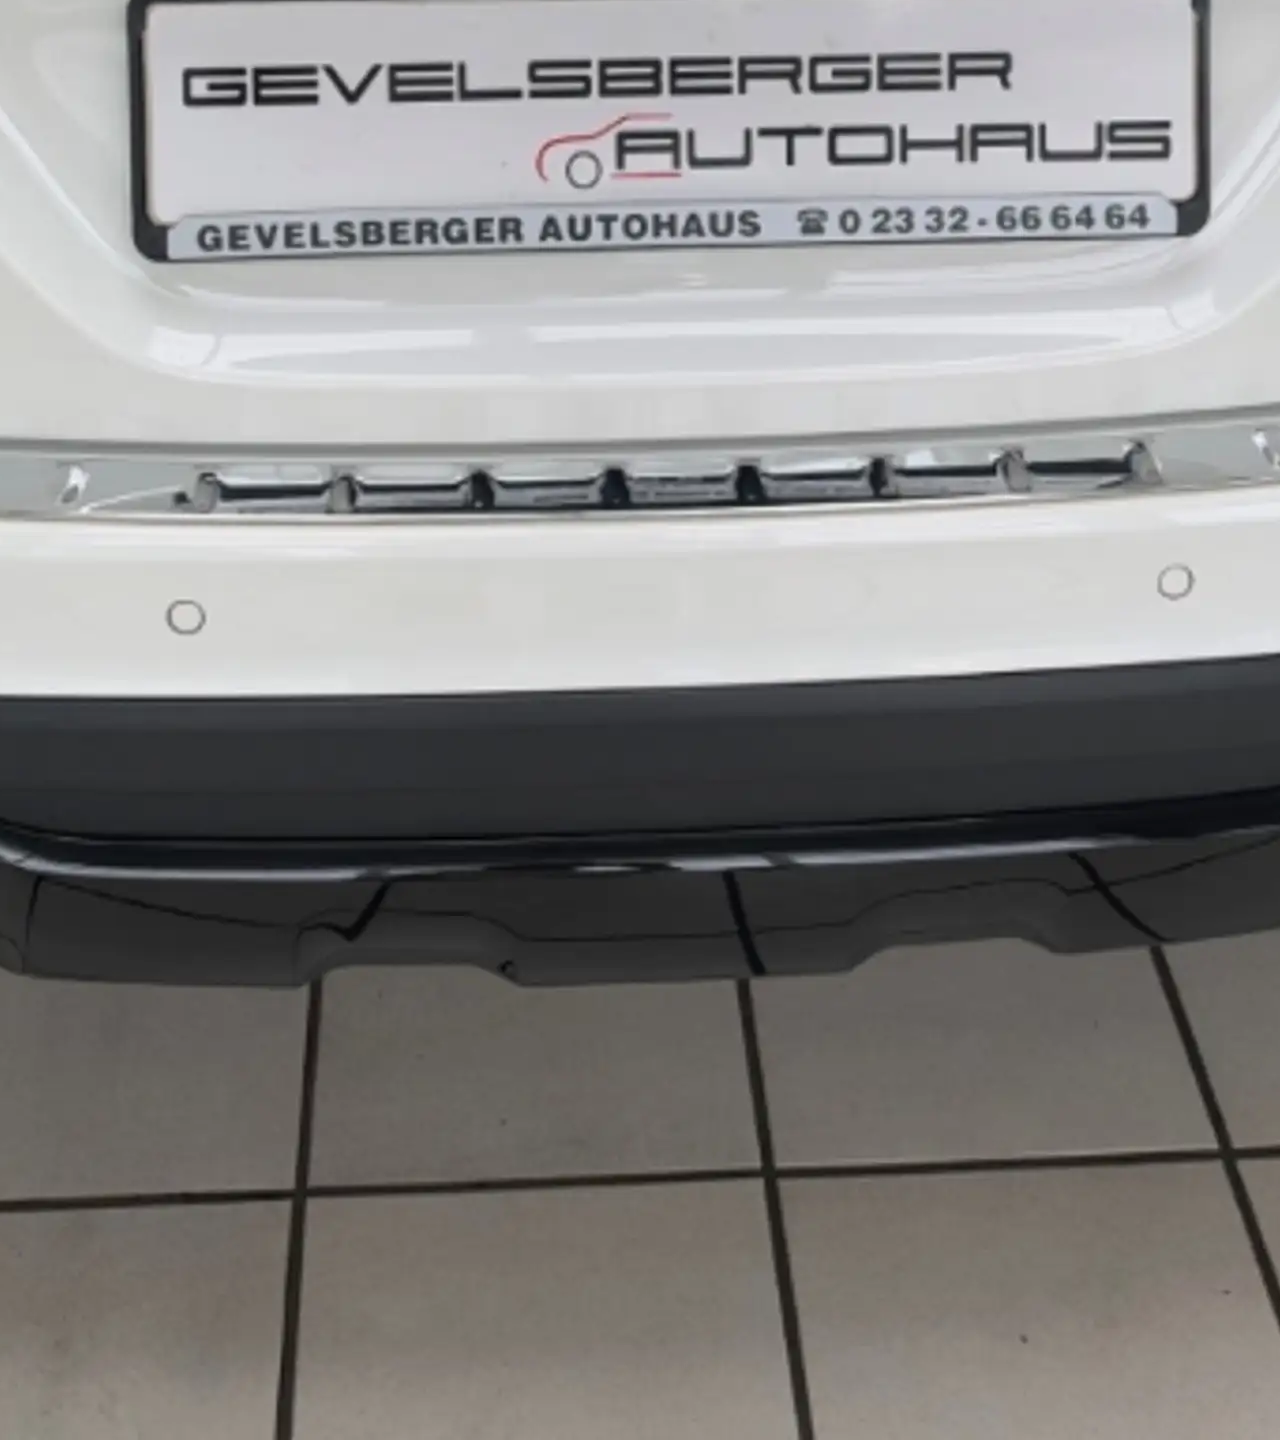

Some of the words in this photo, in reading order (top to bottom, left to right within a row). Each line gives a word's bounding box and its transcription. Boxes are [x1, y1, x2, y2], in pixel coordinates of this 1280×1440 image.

[182, 51, 1014, 108] GEVELSBERGER
[615, 120, 1173, 171] AUTOHAUS
[197, 216, 524, 252] GEVELSBERGER
[538, 210, 762, 245] AUTOHAUS
